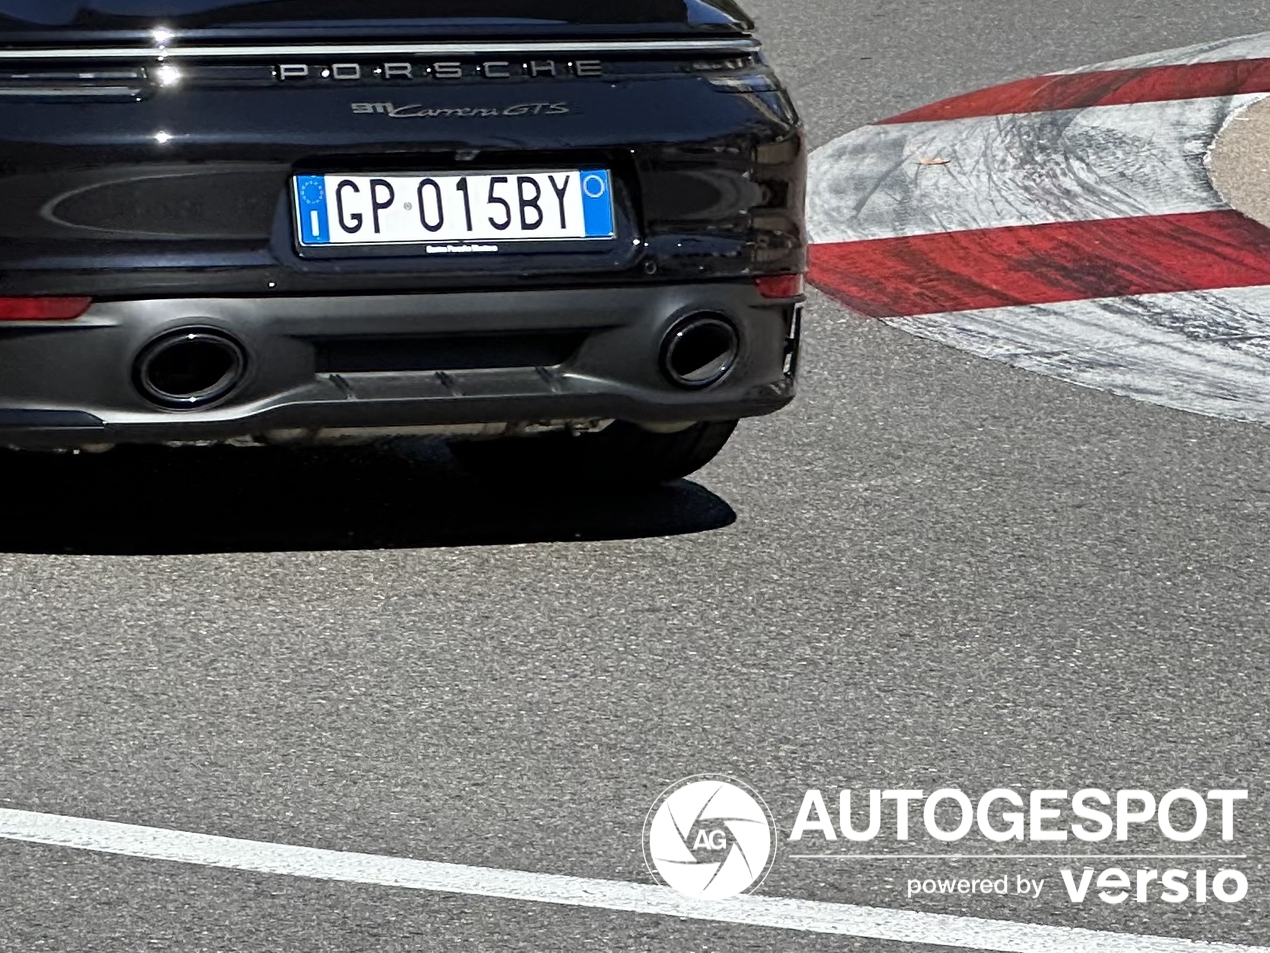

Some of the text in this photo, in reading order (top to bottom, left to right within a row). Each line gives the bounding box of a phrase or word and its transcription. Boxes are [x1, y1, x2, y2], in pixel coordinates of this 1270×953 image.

[279, 59, 602, 81] PORSCHE
[351, 102, 570, 117] 911 Carrera GTS
[335, 175, 571, 234] GP 015BY
